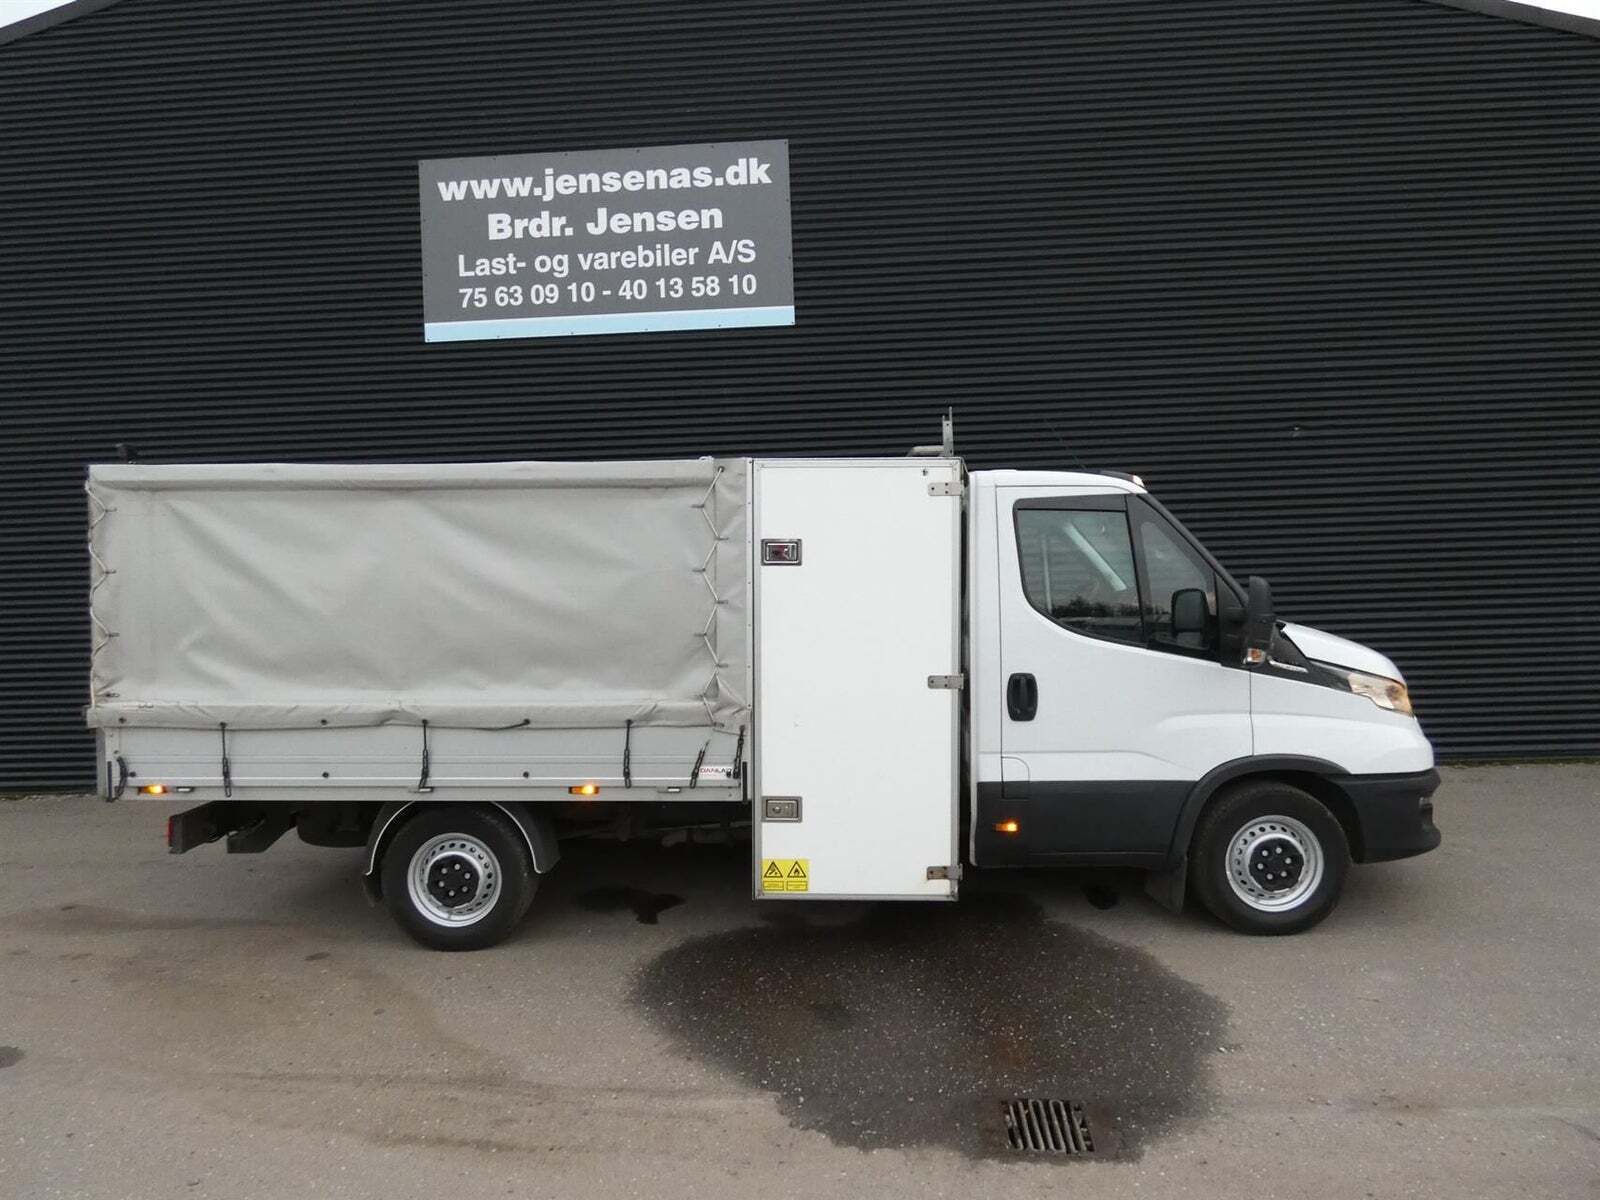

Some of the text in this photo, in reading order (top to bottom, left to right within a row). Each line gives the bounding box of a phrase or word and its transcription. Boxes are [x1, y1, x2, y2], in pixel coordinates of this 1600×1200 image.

[437, 157, 772, 202] www.jensenas.dk
[487, 207, 723, 240] Brdr. Jensen
[458, 239, 757, 277] Last- og varebiler A/S
[458, 286, 488, 309] 75
[494, 285, 524, 307] 63
[530, 283, 560, 305] 09
[567, 281, 596, 303] 10
[618, 279, 648, 300] 40
[655, 277, 684, 299] 13
[691, 275, 721, 297] 58
[729, 273, 758, 295] 10
